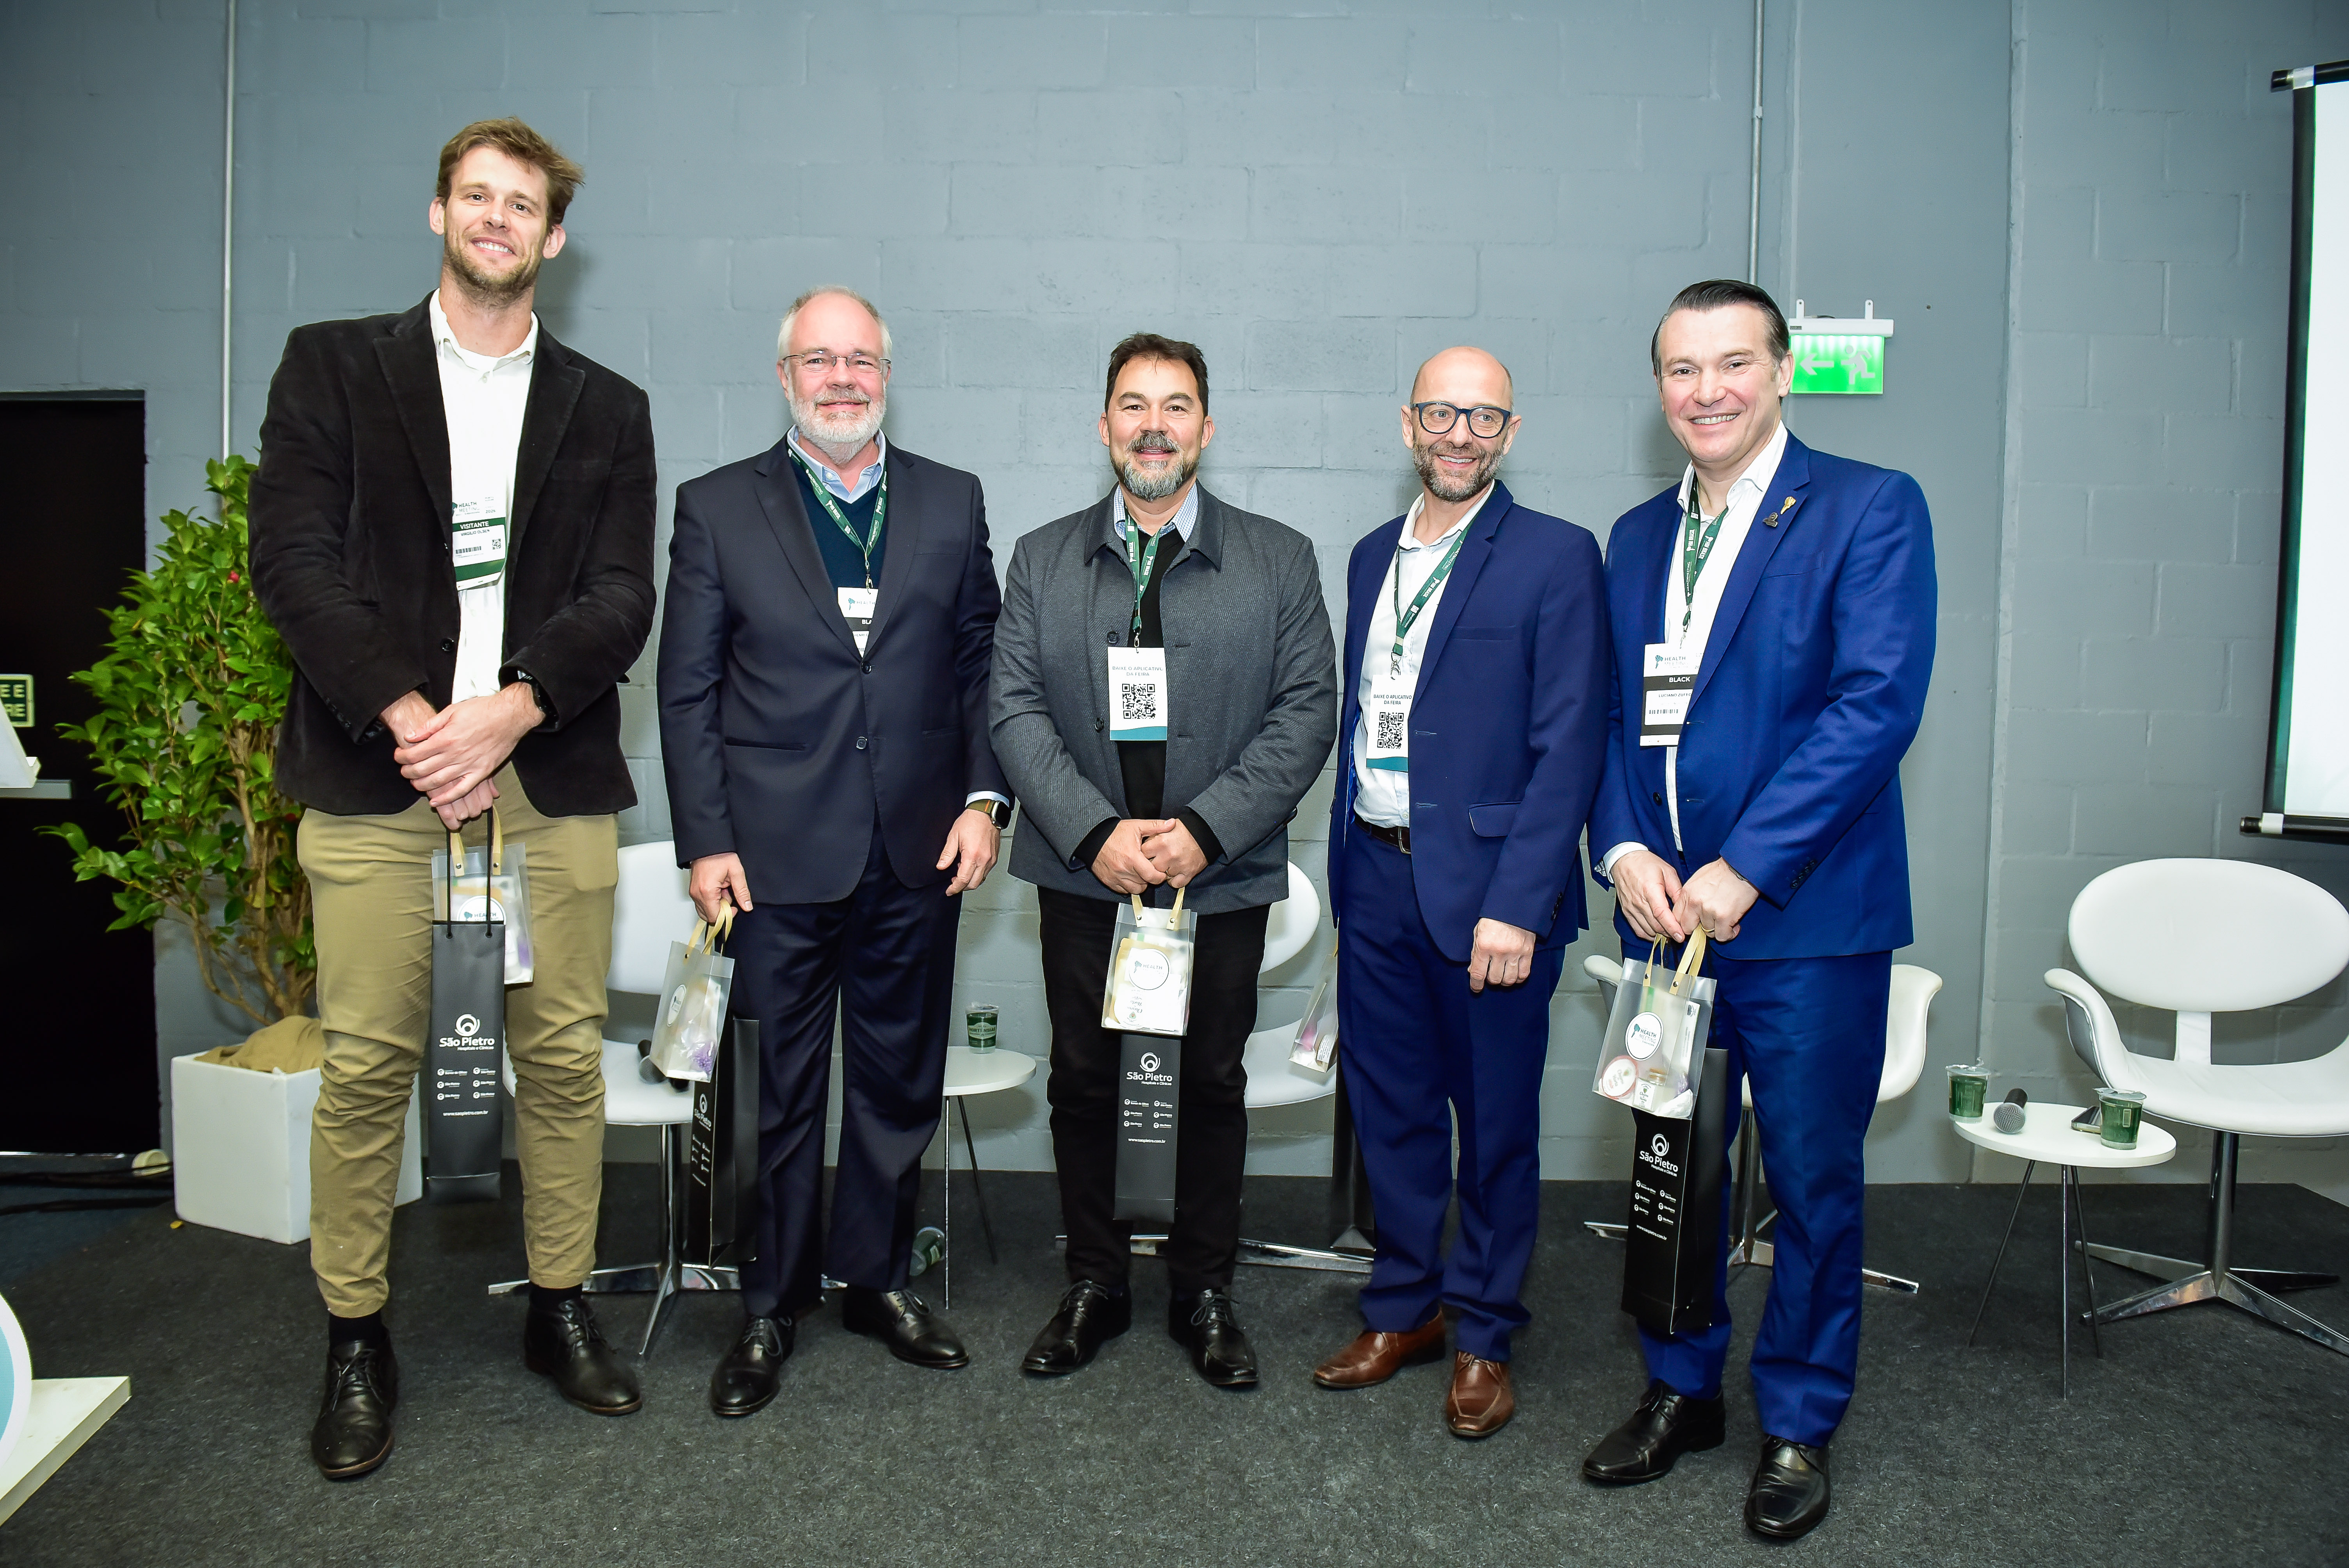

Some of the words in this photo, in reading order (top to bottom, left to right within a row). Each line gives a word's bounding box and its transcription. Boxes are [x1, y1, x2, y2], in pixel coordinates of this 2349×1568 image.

[1639, 1034, 1656, 1043] MEETING
[1641, 1029, 1656, 1038] HEALTH
[439, 1037, 461, 1047] São
[462, 1037, 495, 1046] Pietro
[1126, 1072, 1143, 1080] São
[1145, 1073, 1173, 1082] Pietro
[1639, 1151, 1654, 1163] São
[1655, 1156, 1678, 1172] Pietro
